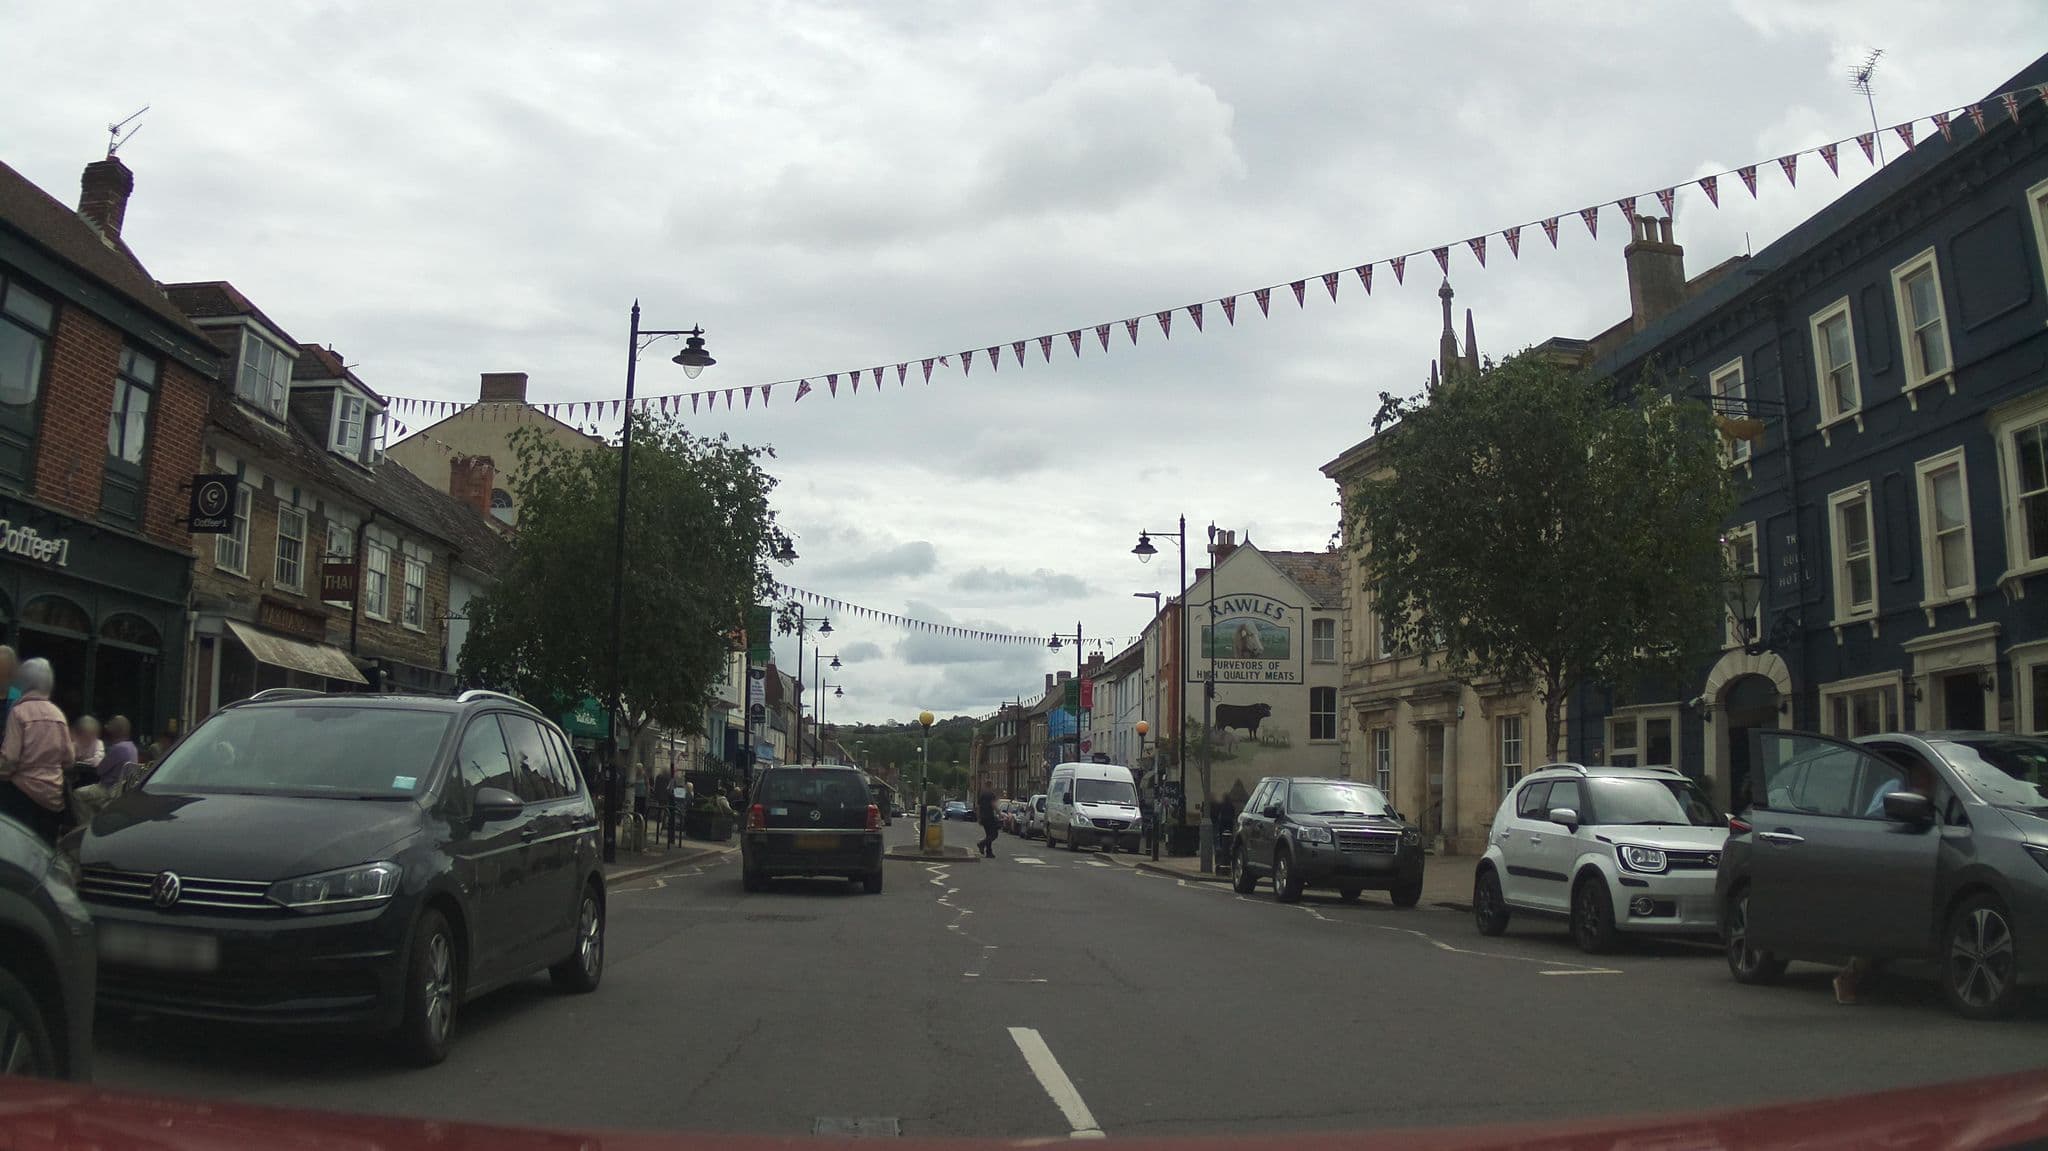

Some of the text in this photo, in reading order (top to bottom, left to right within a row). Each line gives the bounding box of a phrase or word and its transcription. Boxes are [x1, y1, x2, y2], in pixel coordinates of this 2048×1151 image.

[324, 575, 353, 590] THAI
[1208, 599, 1284, 620] RAWLES
[1212, 660, 1280, 670] PURVEYORS OF
[1223, 671, 1260, 680] QUALITY
[1265, 672, 1294, 681] MEATS
